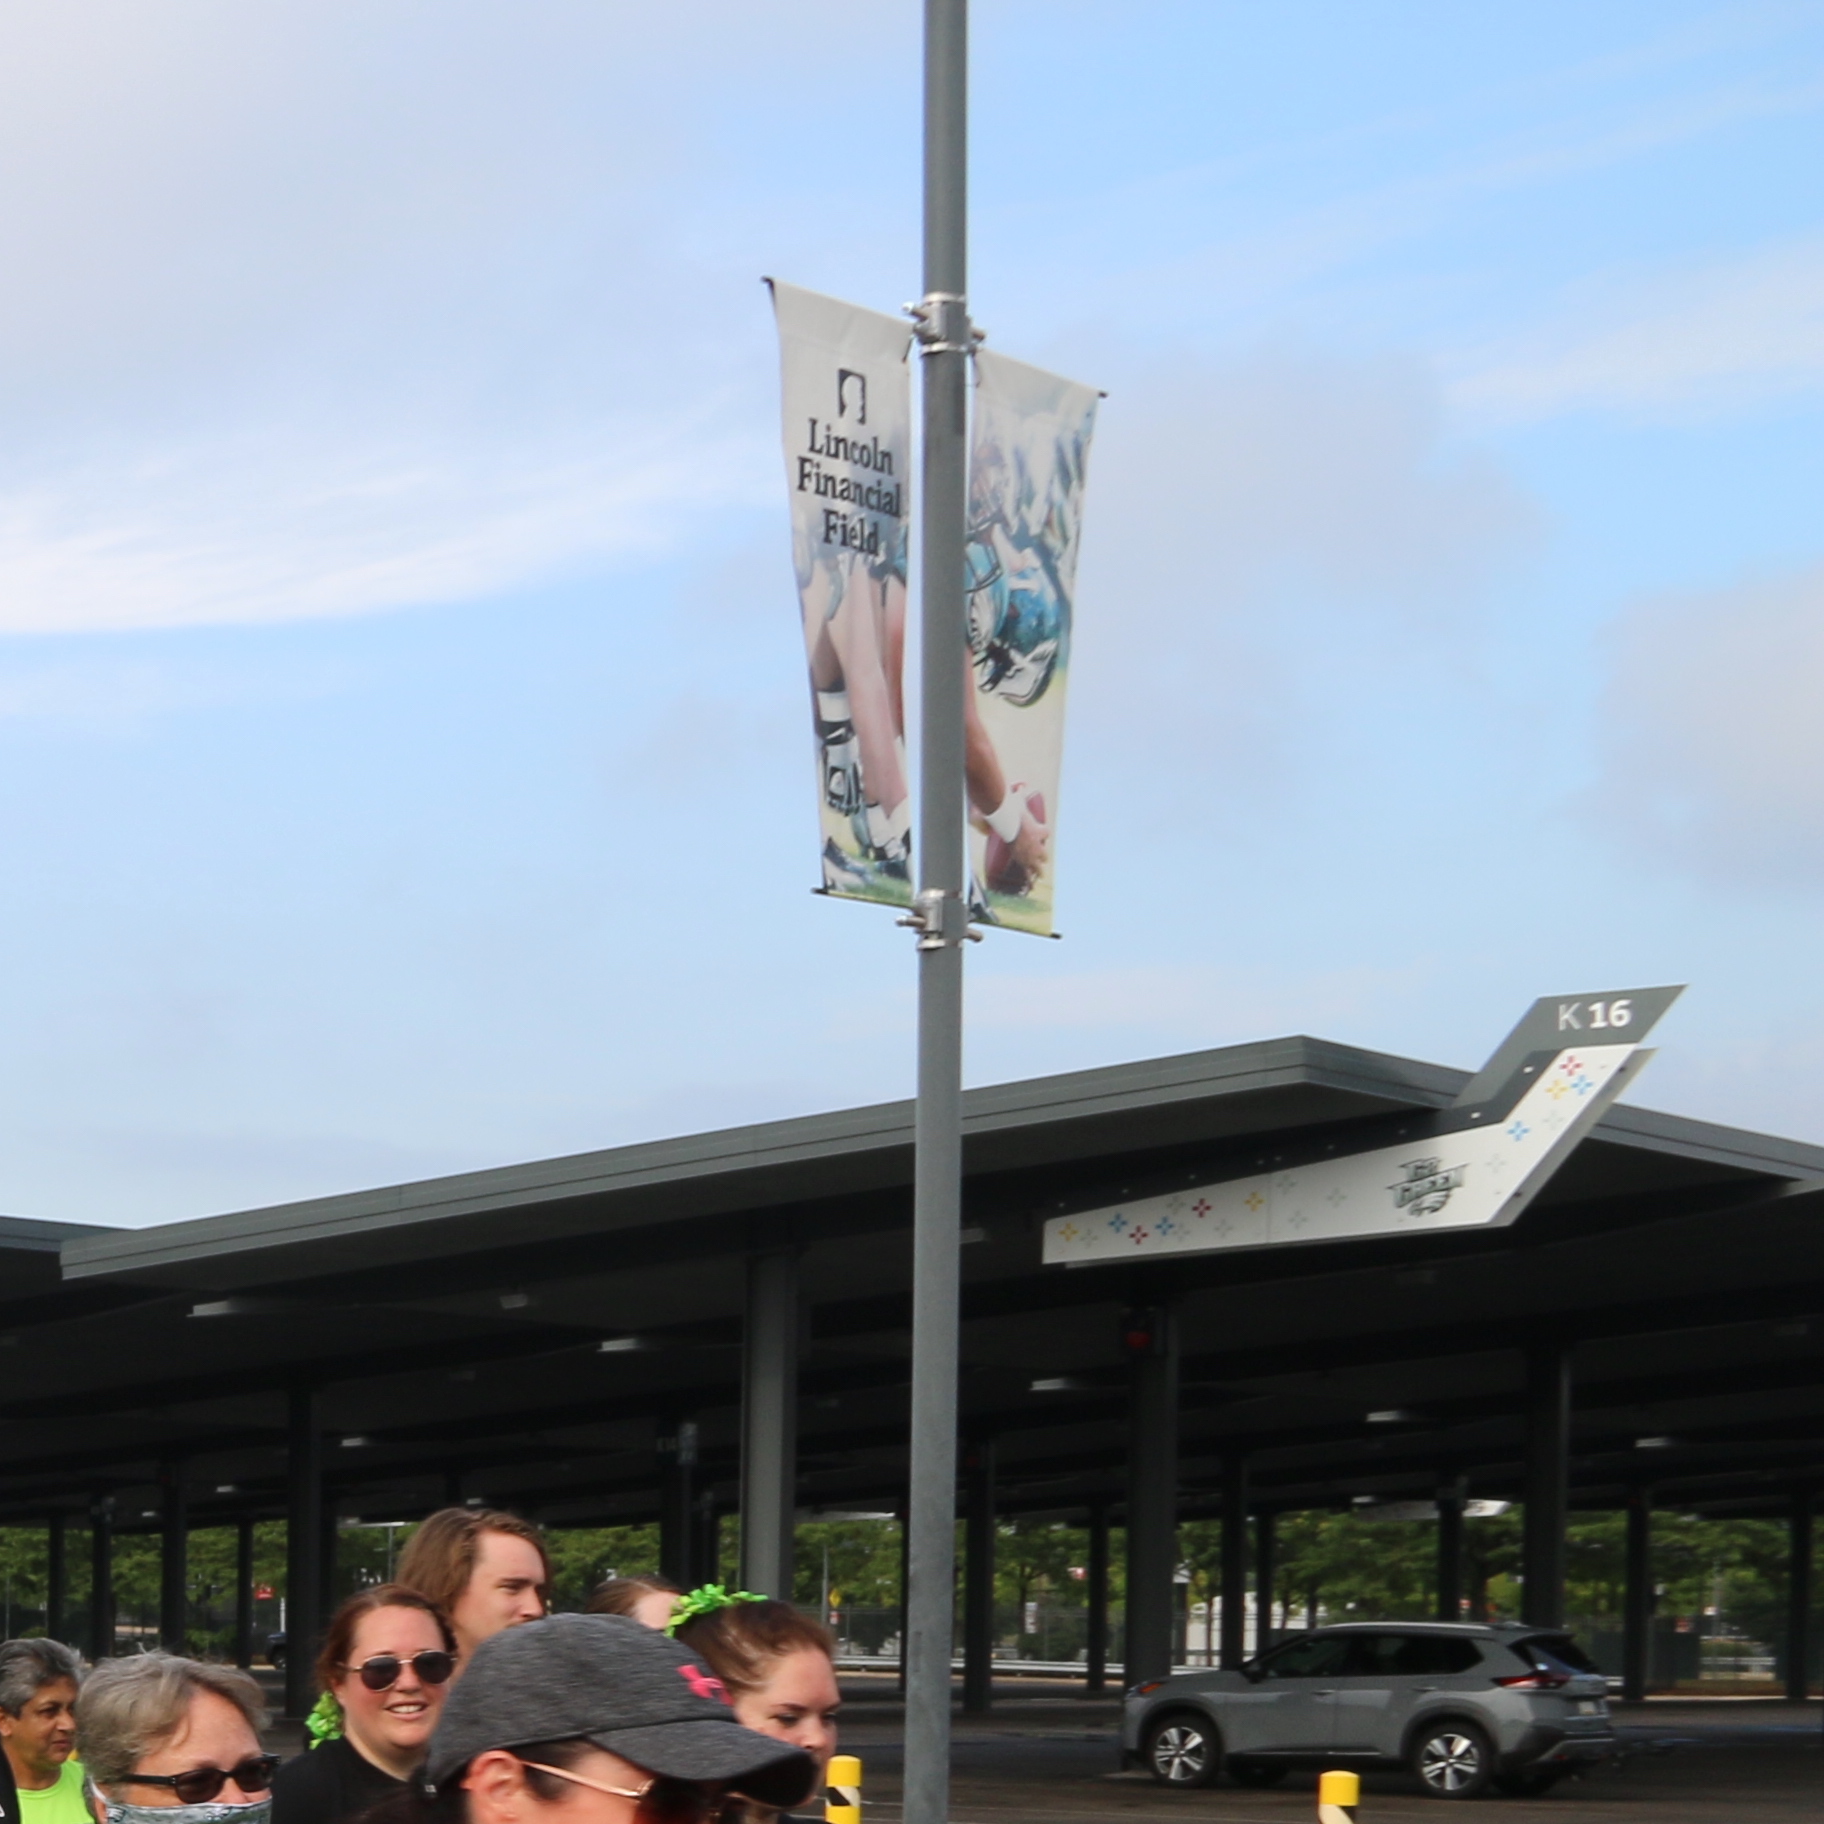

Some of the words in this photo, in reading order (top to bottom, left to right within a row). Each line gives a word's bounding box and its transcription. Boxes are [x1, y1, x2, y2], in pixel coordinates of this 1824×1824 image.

[808, 417, 894, 476] Lincoln
[797, 456, 902, 518] Financial
[823, 508, 880, 556] Field
[1558, 1002, 1582, 1032] K
[1588, 999, 1633, 1029] 16
